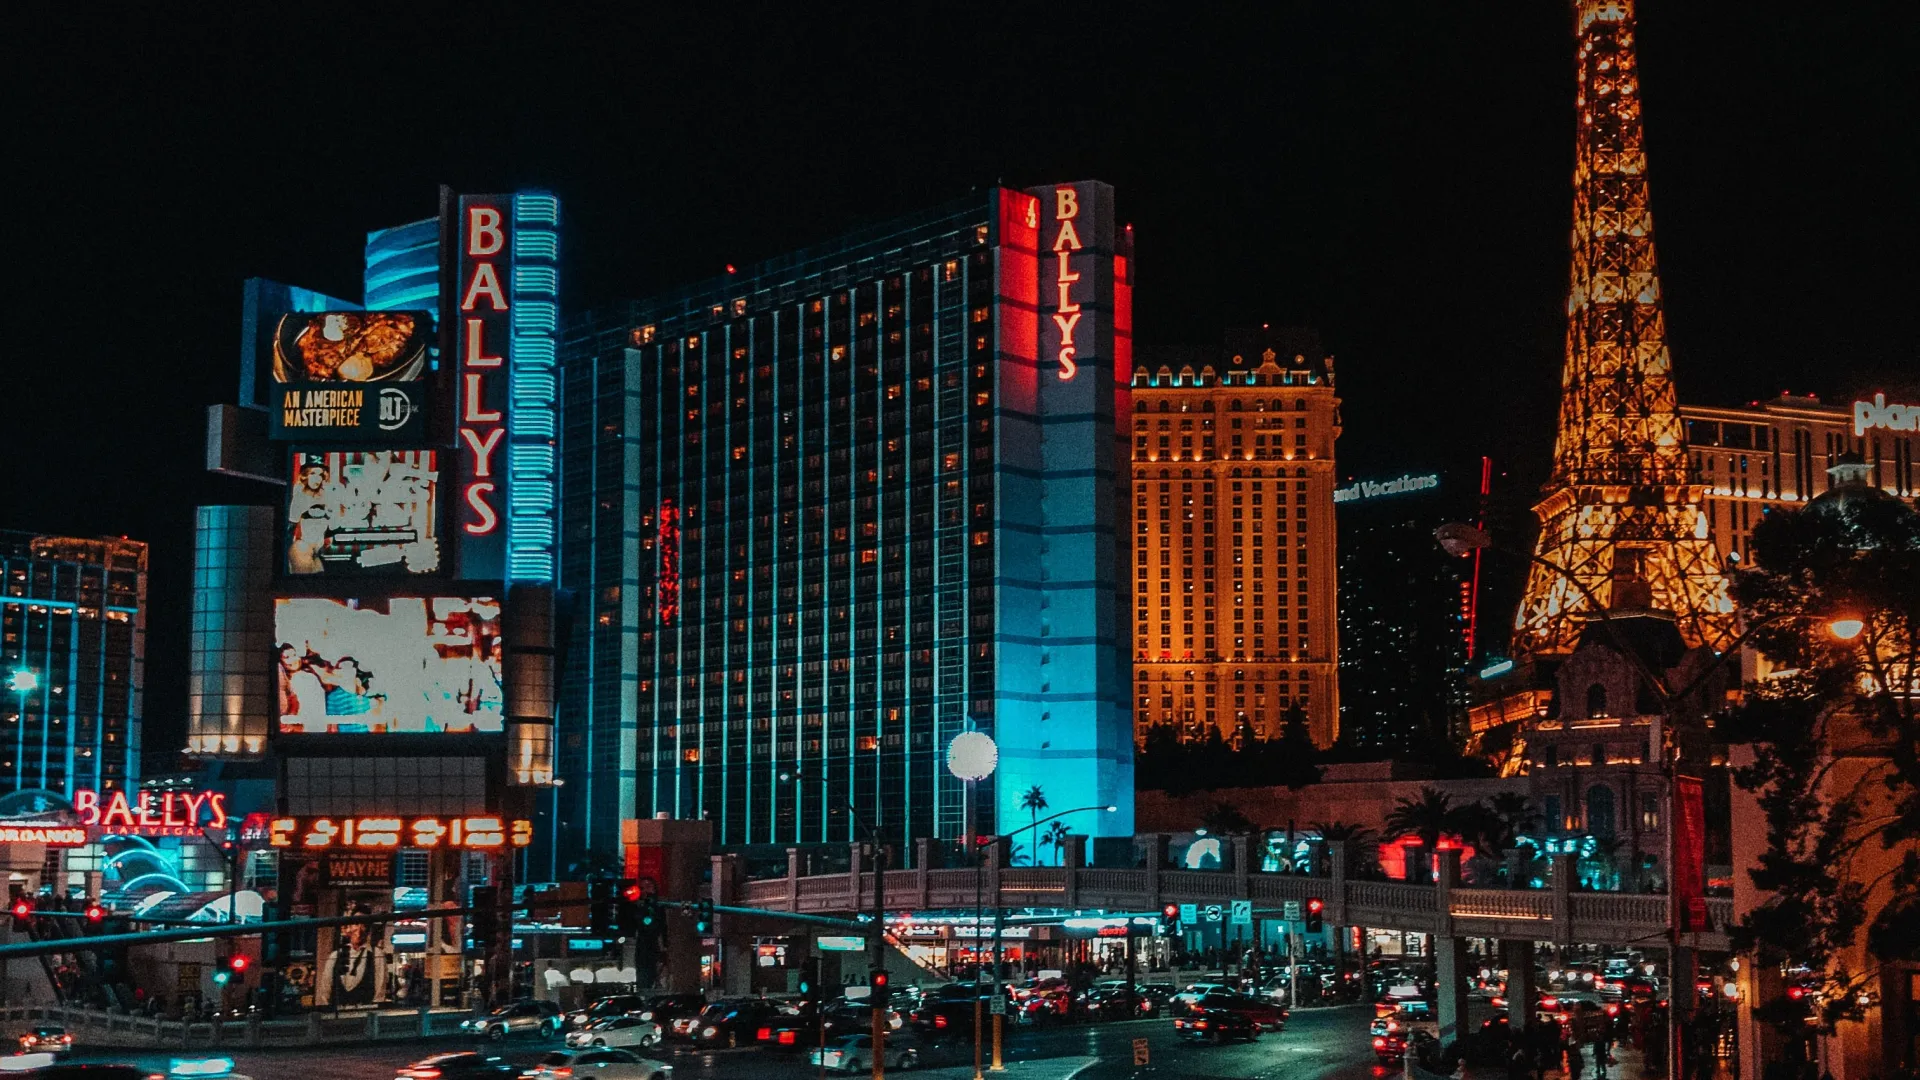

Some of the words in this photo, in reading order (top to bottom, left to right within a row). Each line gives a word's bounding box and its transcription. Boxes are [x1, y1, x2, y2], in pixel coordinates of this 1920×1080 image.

[461, 207, 508, 534] BALLYS
[284, 391, 300, 408] AN
[305, 390, 363, 408] AMERICAN
[284, 408, 360, 427] MASTERPIECE
[1361, 475, 1437, 497] Vacations
[75, 790, 226, 828] BALLY'S
[106, 826, 140, 835] LAS
[329, 861, 389, 877] WAYNE
